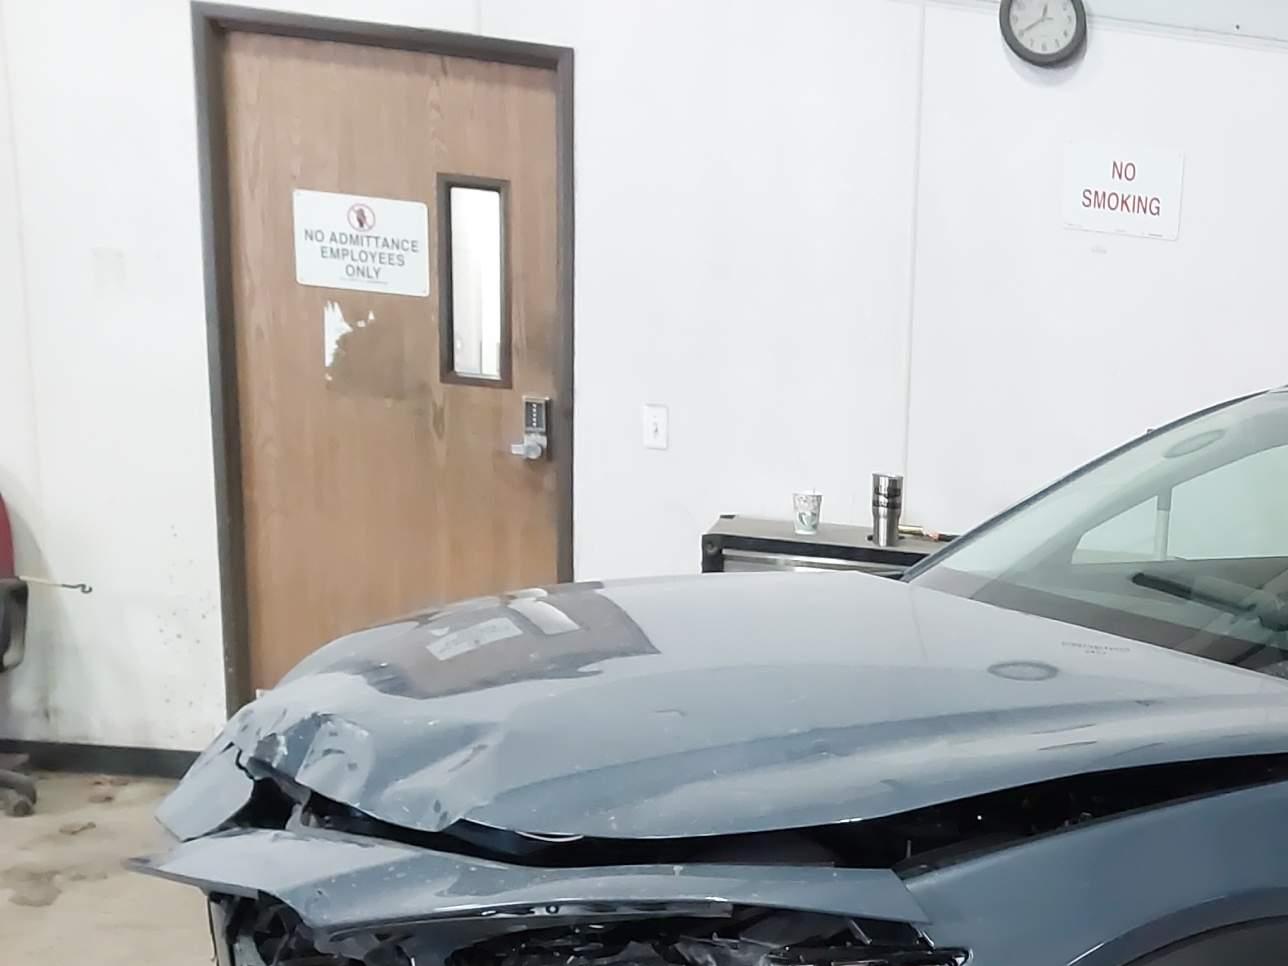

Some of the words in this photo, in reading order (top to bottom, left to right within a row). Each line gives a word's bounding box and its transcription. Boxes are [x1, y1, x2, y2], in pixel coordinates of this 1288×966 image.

[1111, 160, 1136, 181] NO
[1081, 188, 1161, 216] SMOKING
[304, 228, 325, 242] NO
[329, 231, 420, 253] ADMITTANCE
[320, 246, 405, 267] EMPLOYEES
[345, 263, 381, 279] ONLY
